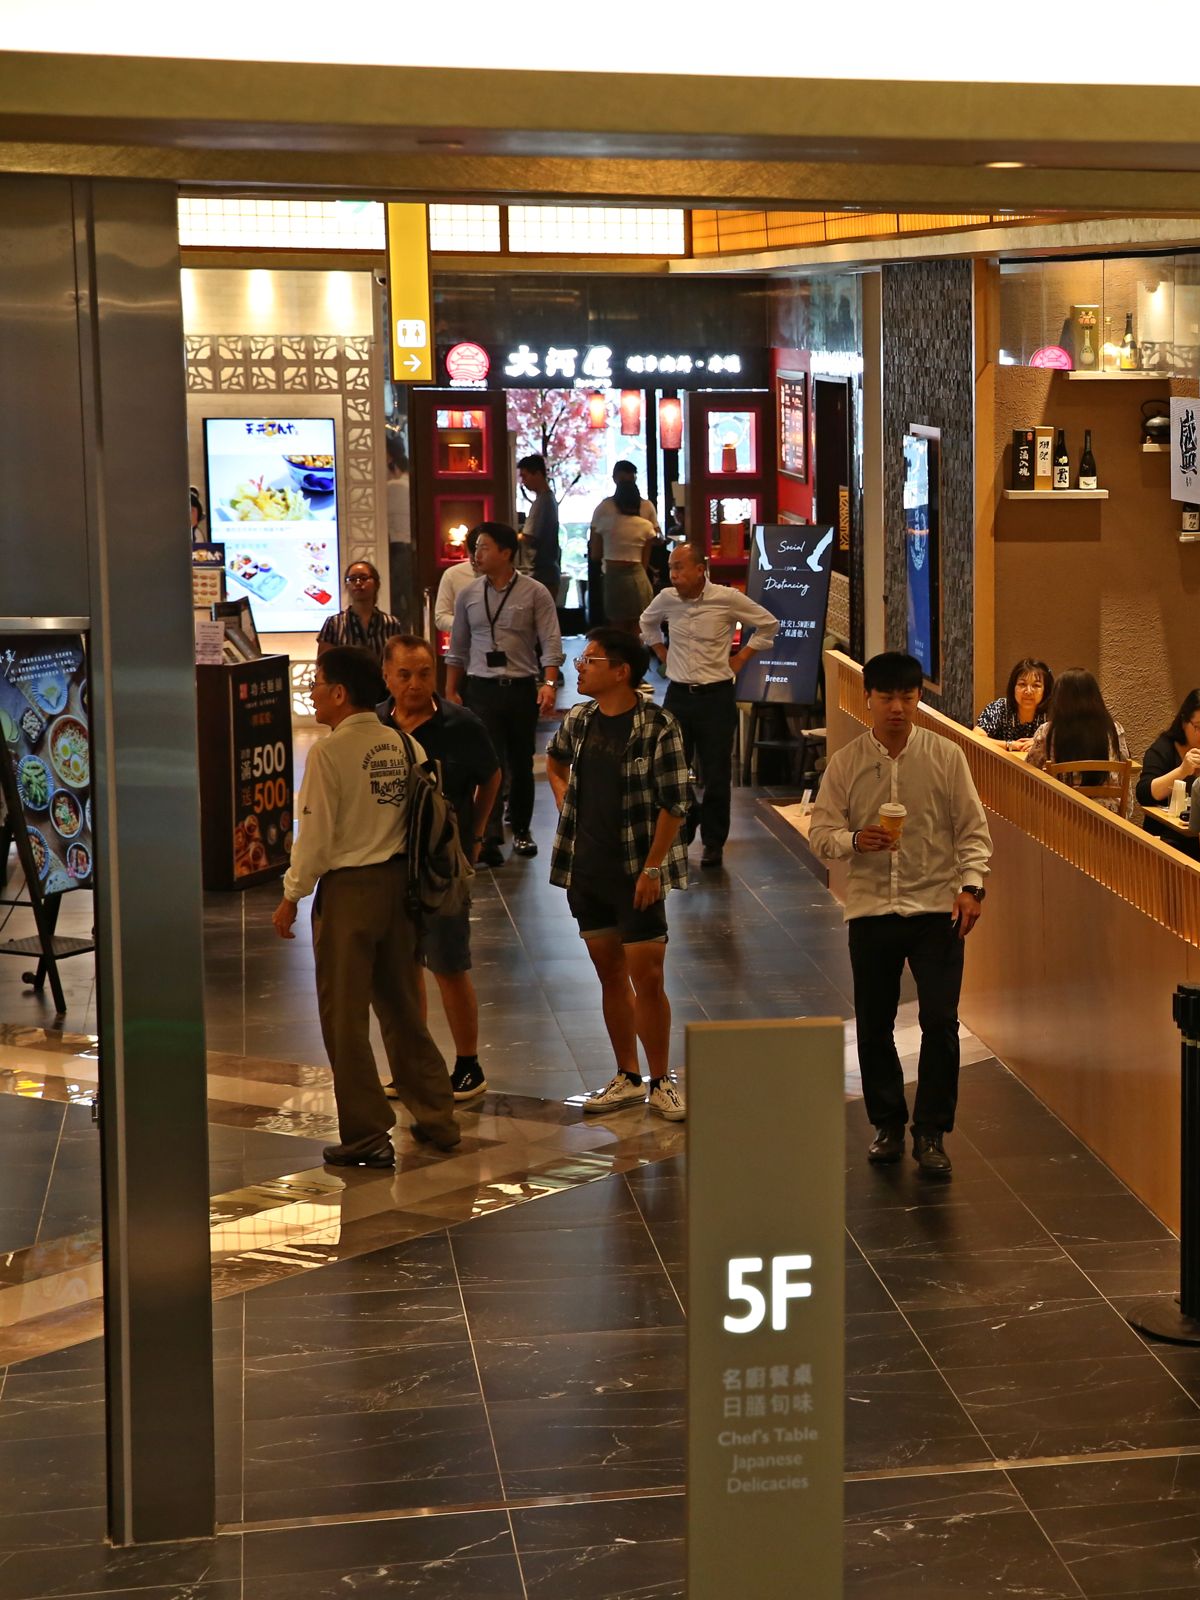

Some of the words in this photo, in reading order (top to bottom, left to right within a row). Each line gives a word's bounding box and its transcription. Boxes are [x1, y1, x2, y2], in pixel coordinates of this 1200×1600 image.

[778, 540, 806, 553] Social
[763, 576, 811, 597] Distancing
[779, 620, 816, 629] 社交1.5M距離
[765, 674, 789, 683] Breeze
[374, 743, 390, 753] GAME
[252, 742, 286, 778] 500
[254, 778, 287, 814] 500
[723, 1254, 812, 1334] 5F
[722, 1364, 813, 1391] 名廚餐桌
[718, 1429, 770, 1446] Chef's
[773, 1426, 818, 1443] Table
[732, 1452, 803, 1474] Japanese
[727, 1475, 809, 1494] Delicacies
